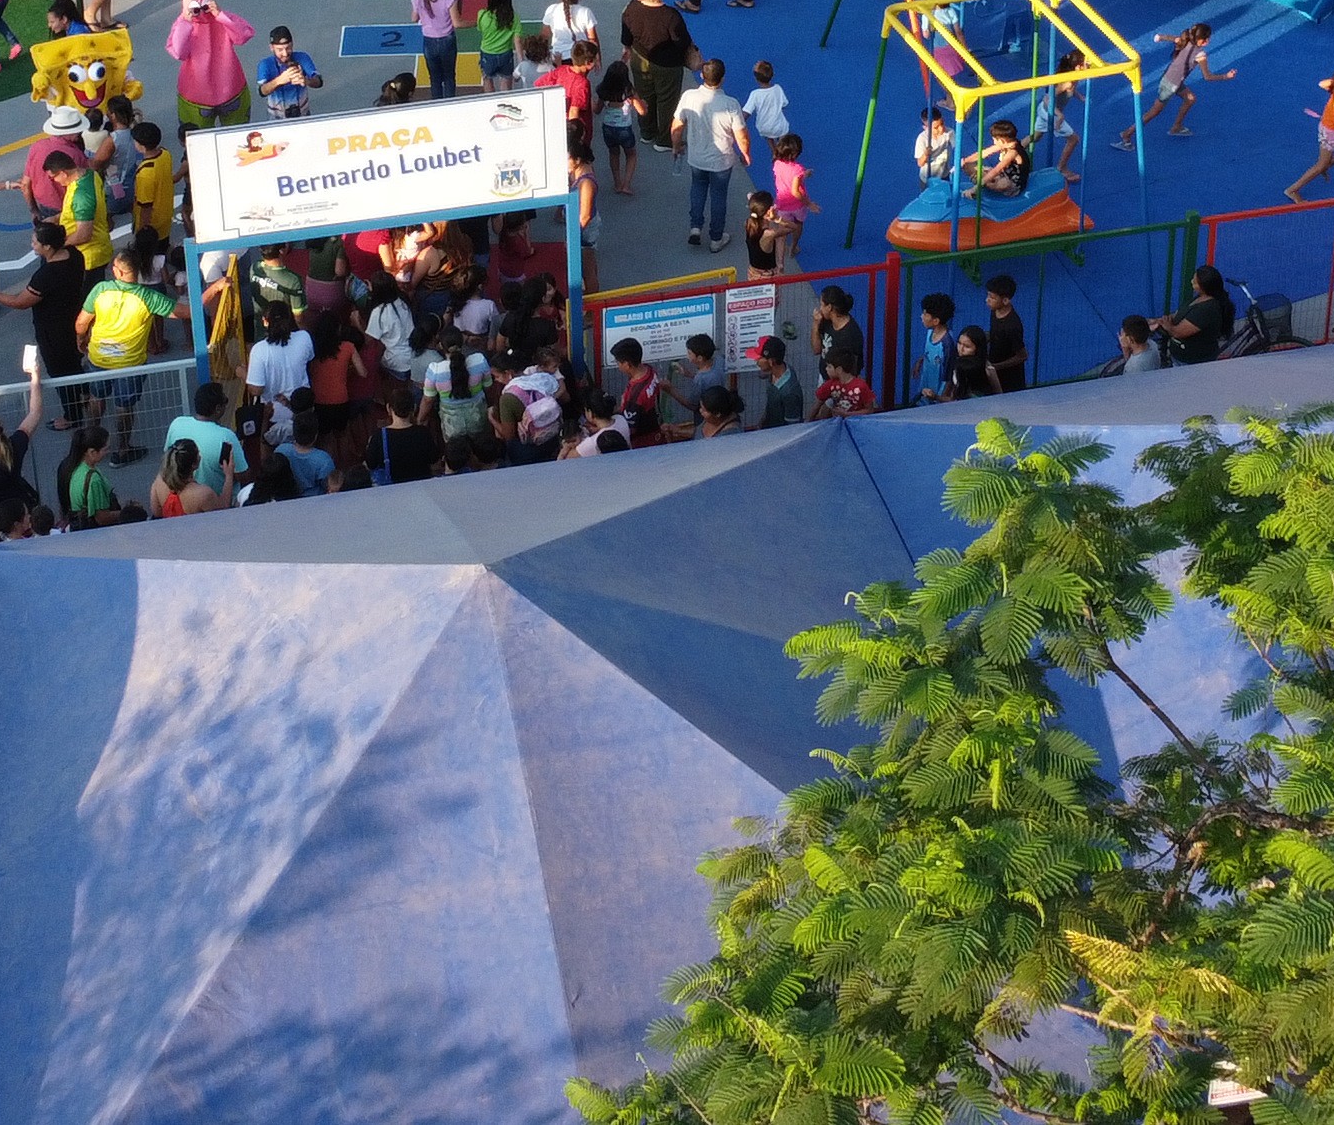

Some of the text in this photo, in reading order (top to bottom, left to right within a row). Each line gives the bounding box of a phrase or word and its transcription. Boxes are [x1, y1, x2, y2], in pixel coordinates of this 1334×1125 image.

[380, 31, 405, 48] 2
[327, 126, 434, 156] PRAÇA
[276, 144, 483, 198] Bernardo Loubet
[645, 311, 652, 319] DE
[643, 337, 673, 346] DOMINGO
